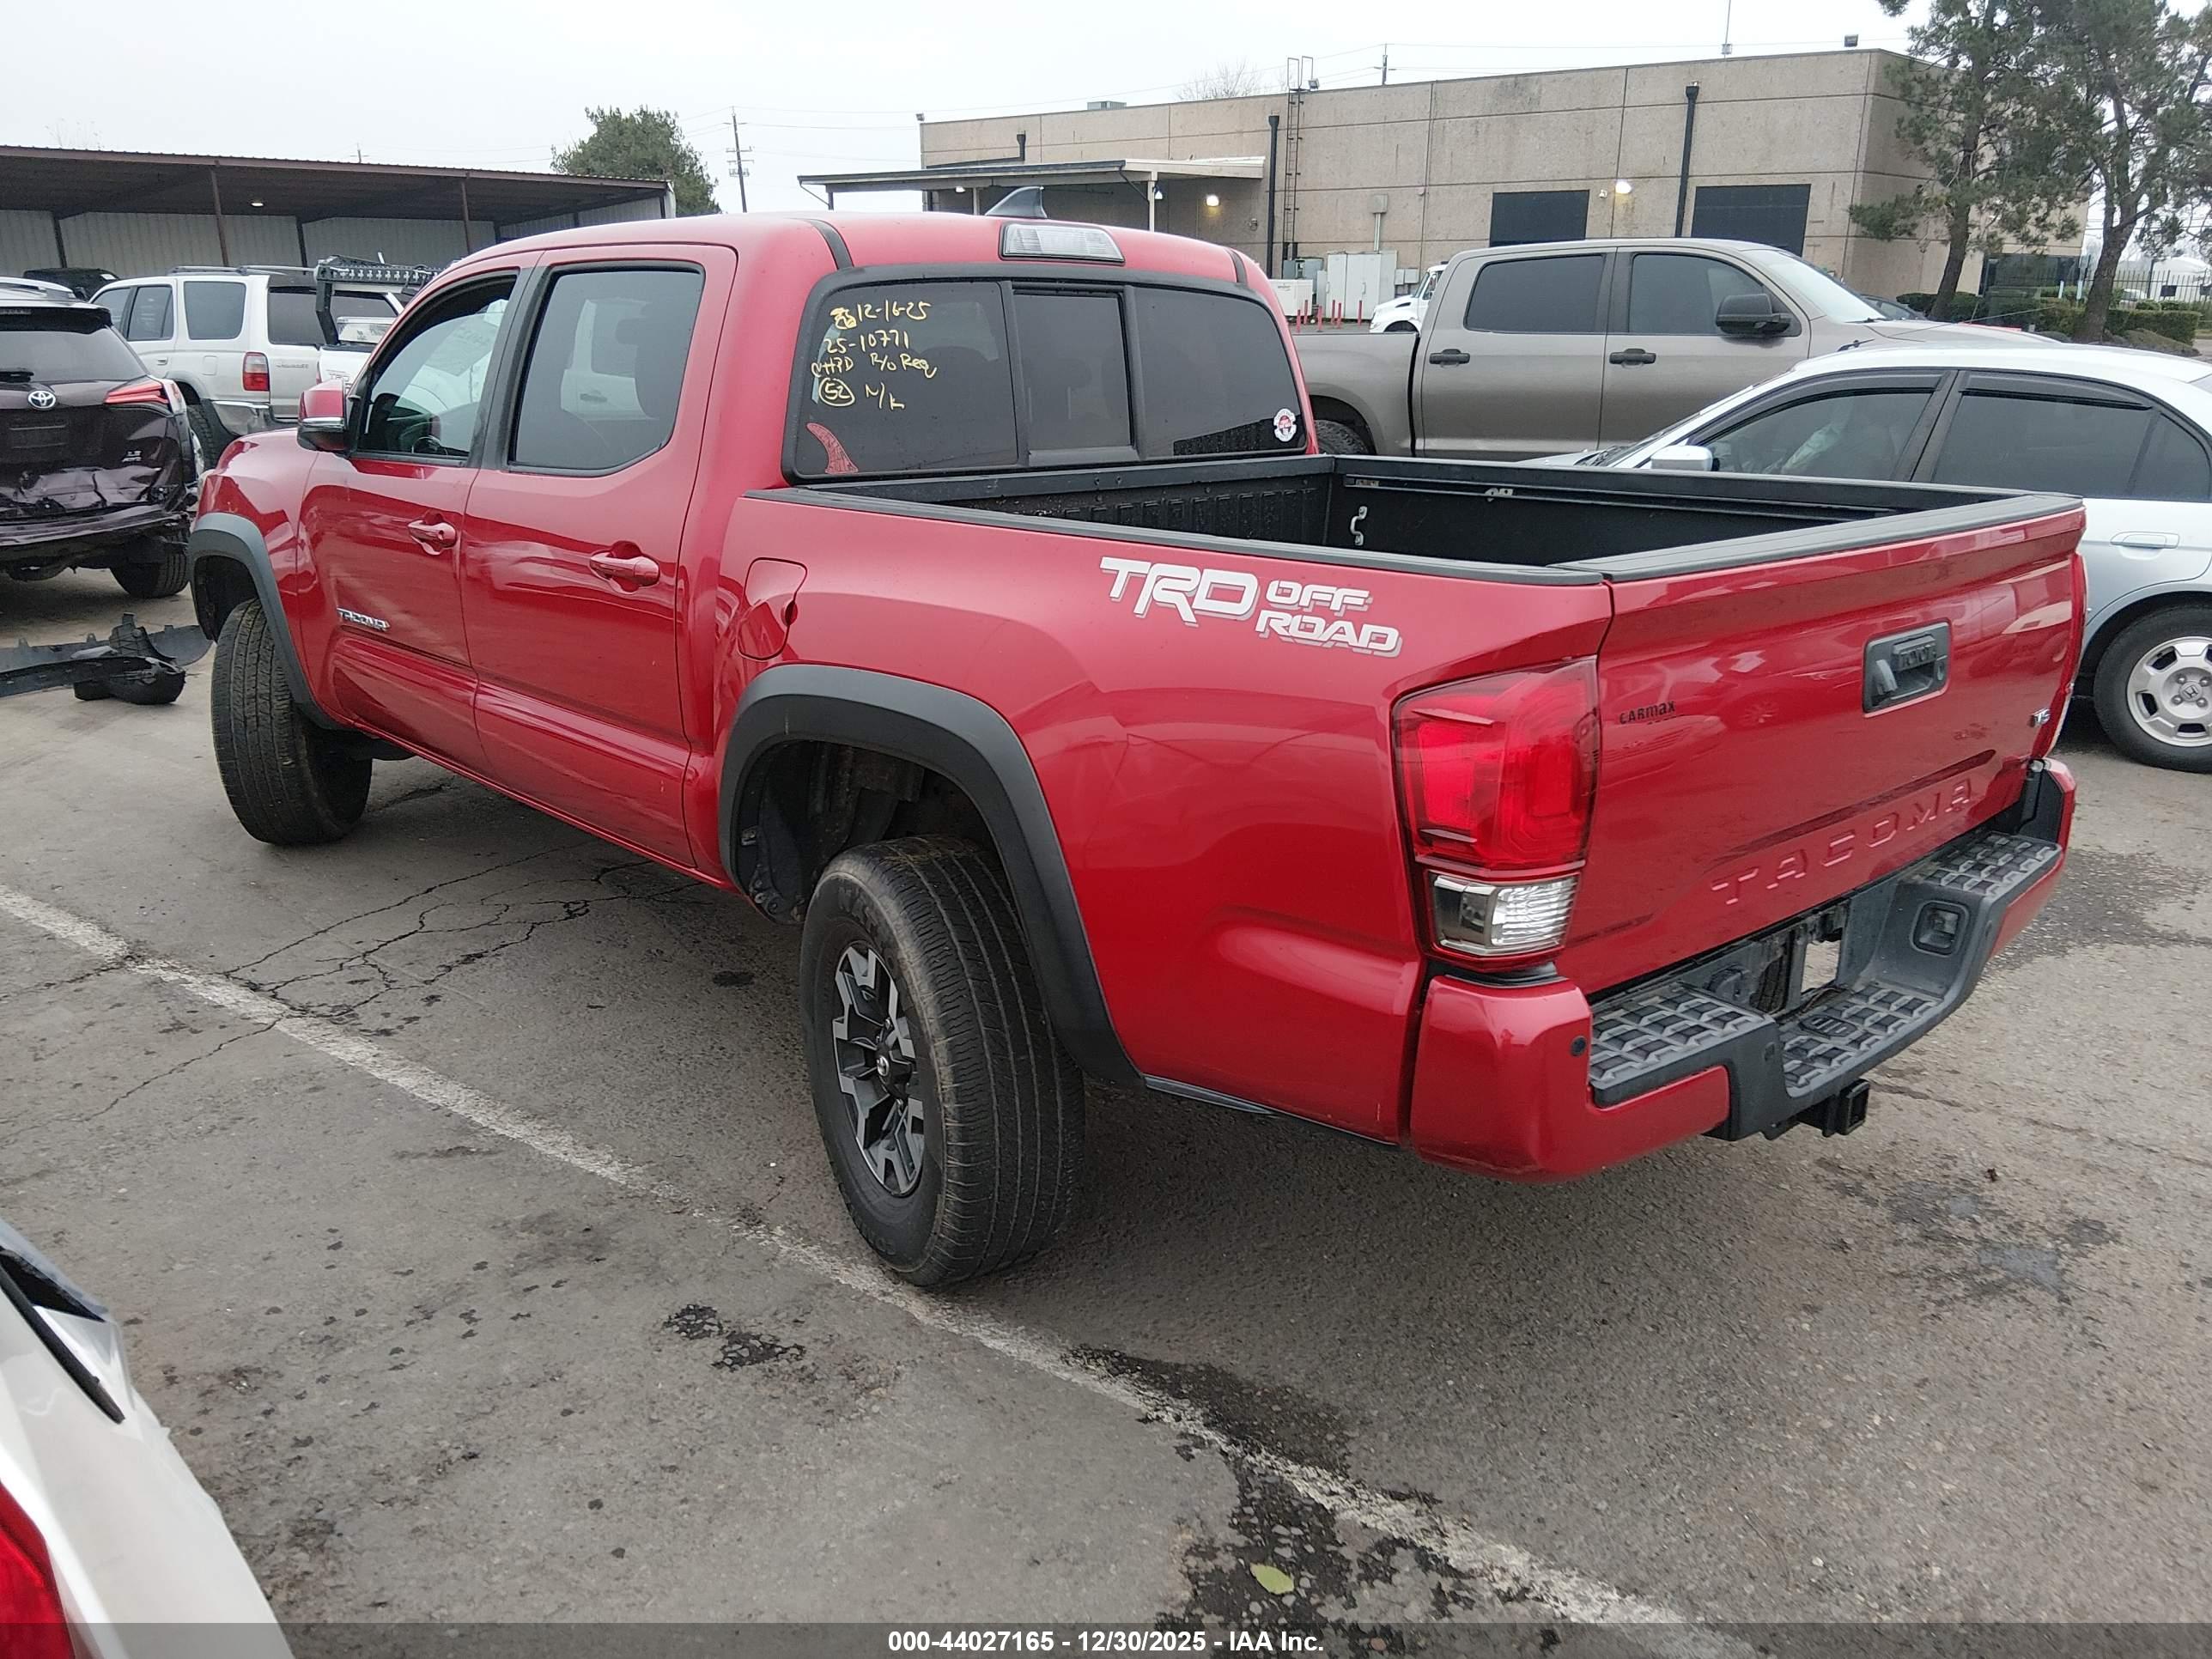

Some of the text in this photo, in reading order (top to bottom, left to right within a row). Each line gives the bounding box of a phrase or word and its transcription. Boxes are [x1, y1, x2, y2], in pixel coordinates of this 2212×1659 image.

[857, 300, 932, 322] 12-16-25
[823, 330, 909, 354] 25-10771
[1099, 556, 1374, 628] TRD OFF
[1254, 609, 1403, 659] ROAD
[1711, 778, 1972, 905] TACOMA
